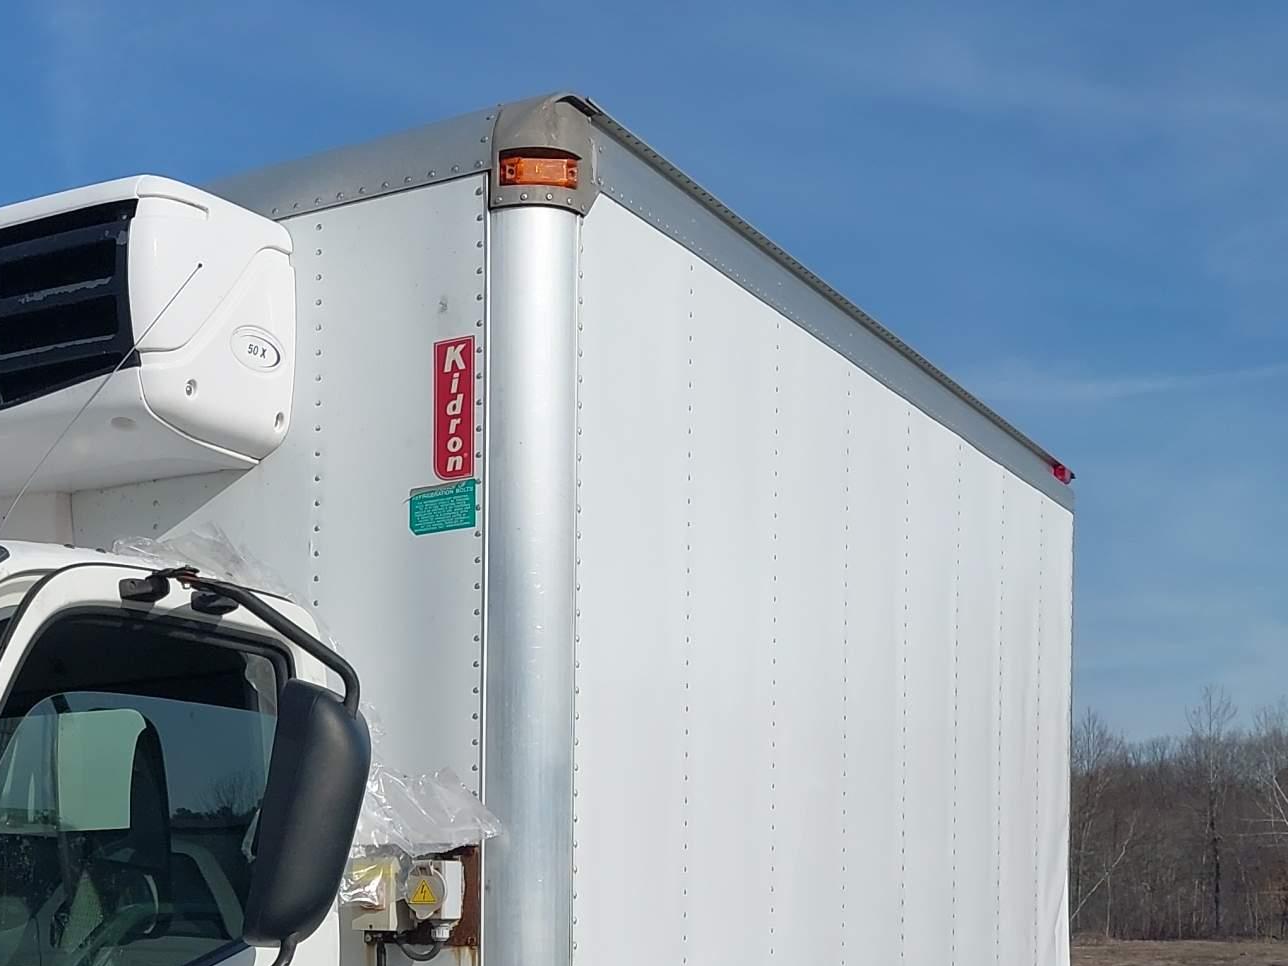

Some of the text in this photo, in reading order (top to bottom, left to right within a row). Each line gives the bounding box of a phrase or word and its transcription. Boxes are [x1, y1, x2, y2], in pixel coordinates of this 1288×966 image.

[247, 344, 267, 359] 50 X
[443, 343, 466, 472] Kidron
